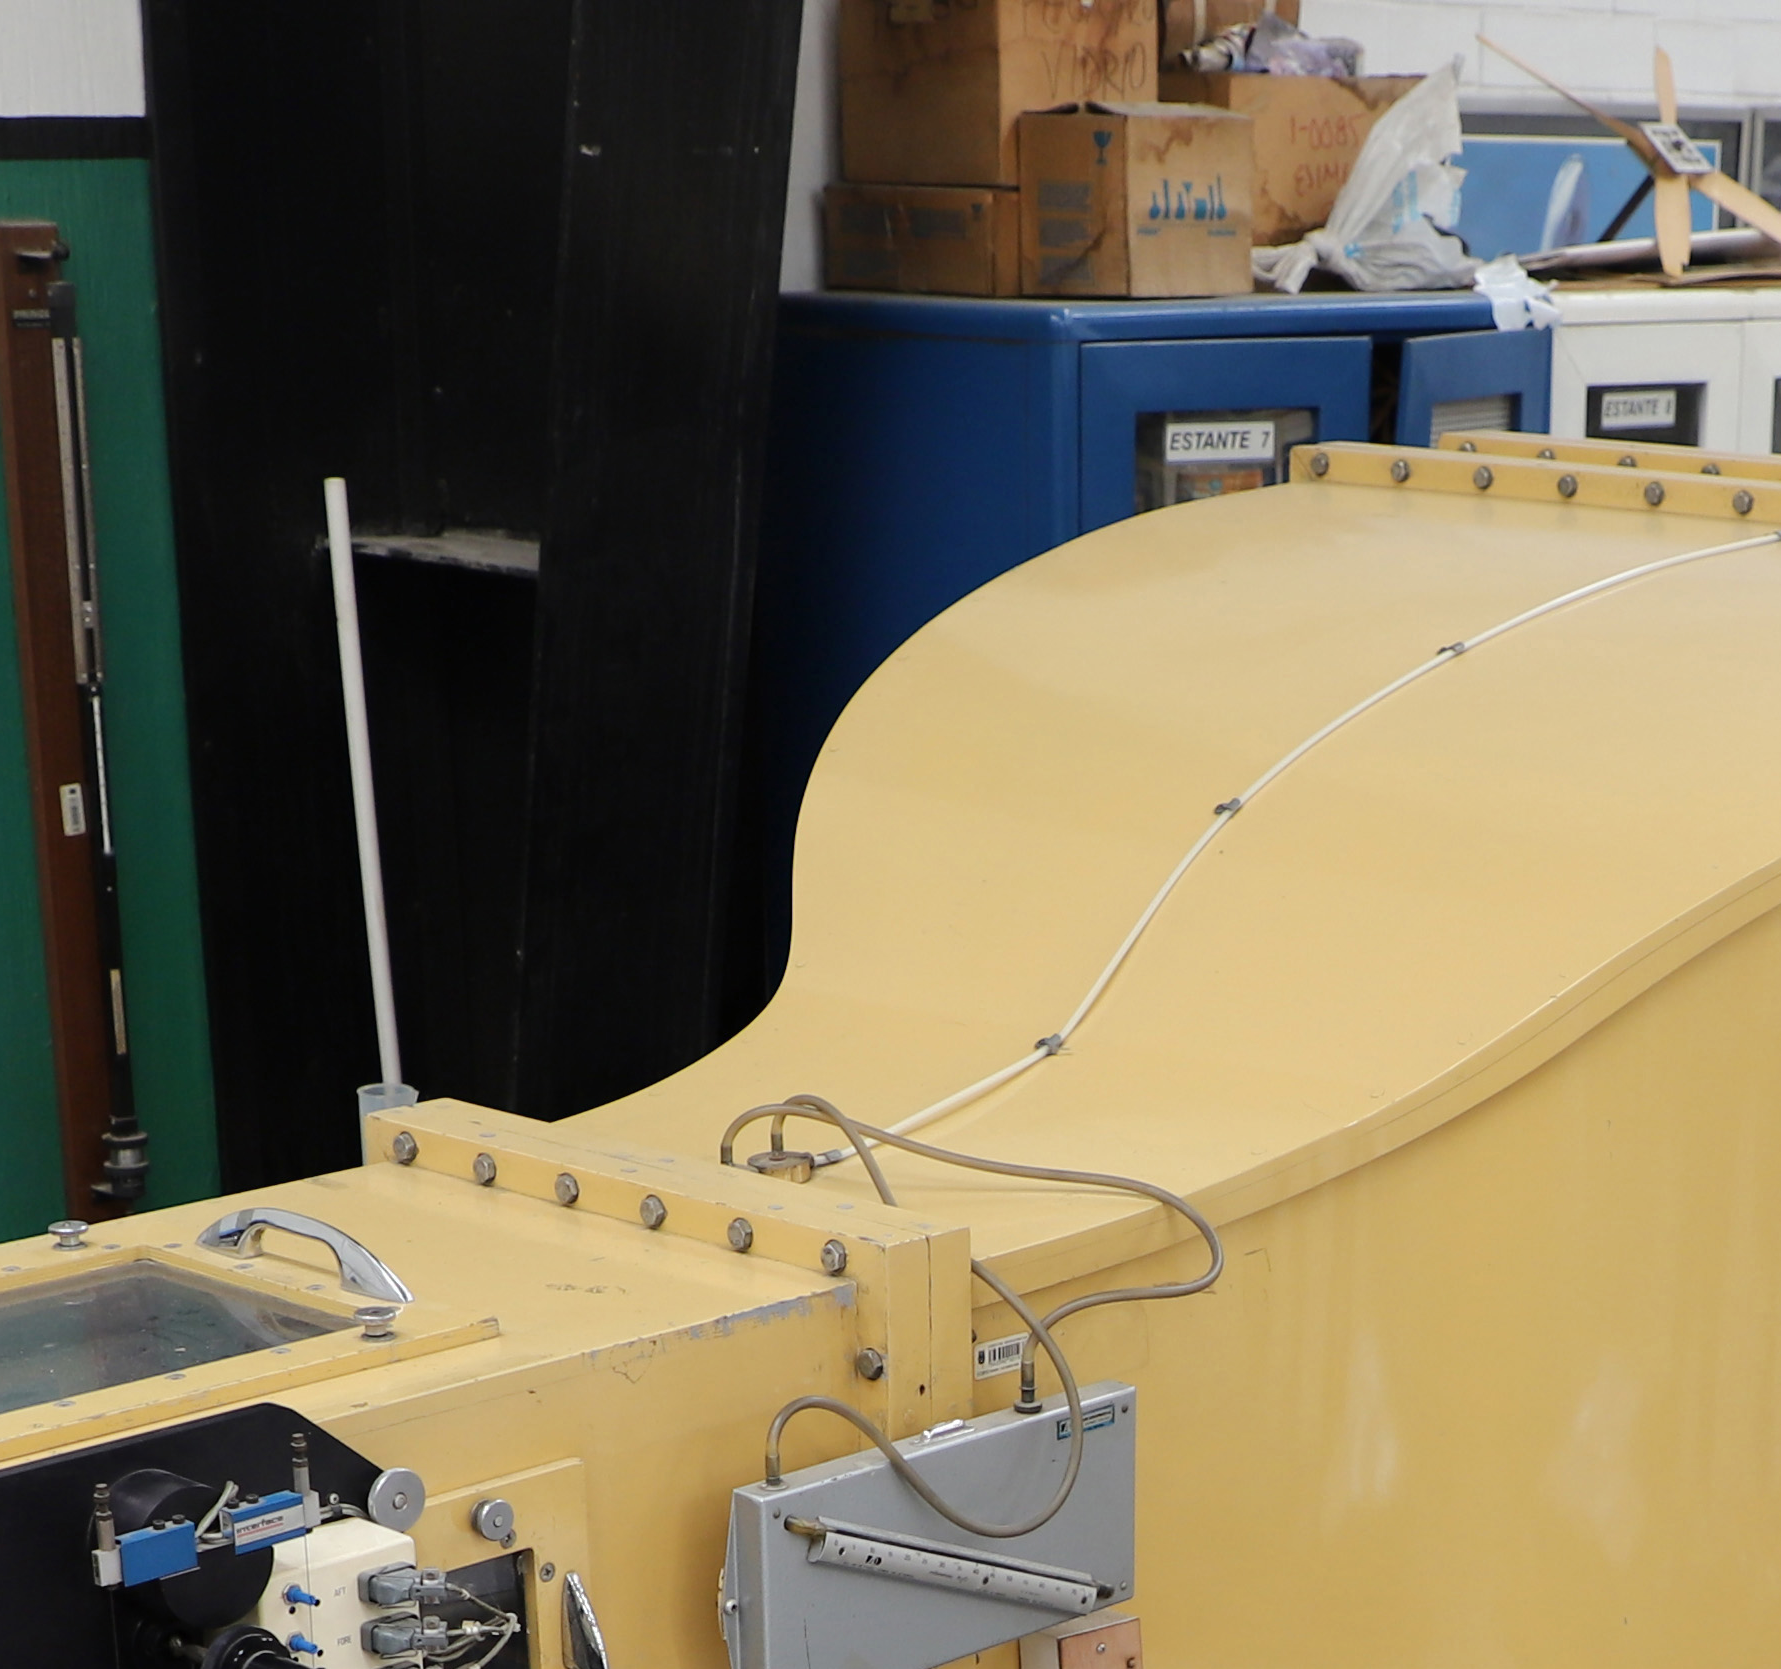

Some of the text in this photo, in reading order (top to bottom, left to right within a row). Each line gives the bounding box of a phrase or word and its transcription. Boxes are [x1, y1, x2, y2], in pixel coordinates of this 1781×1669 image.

[1041, 42, 1146, 100] VIDRIO
[1170, 431, 1271, 450] ESTANTE 7
[236, 1515, 284, 1535] interface
